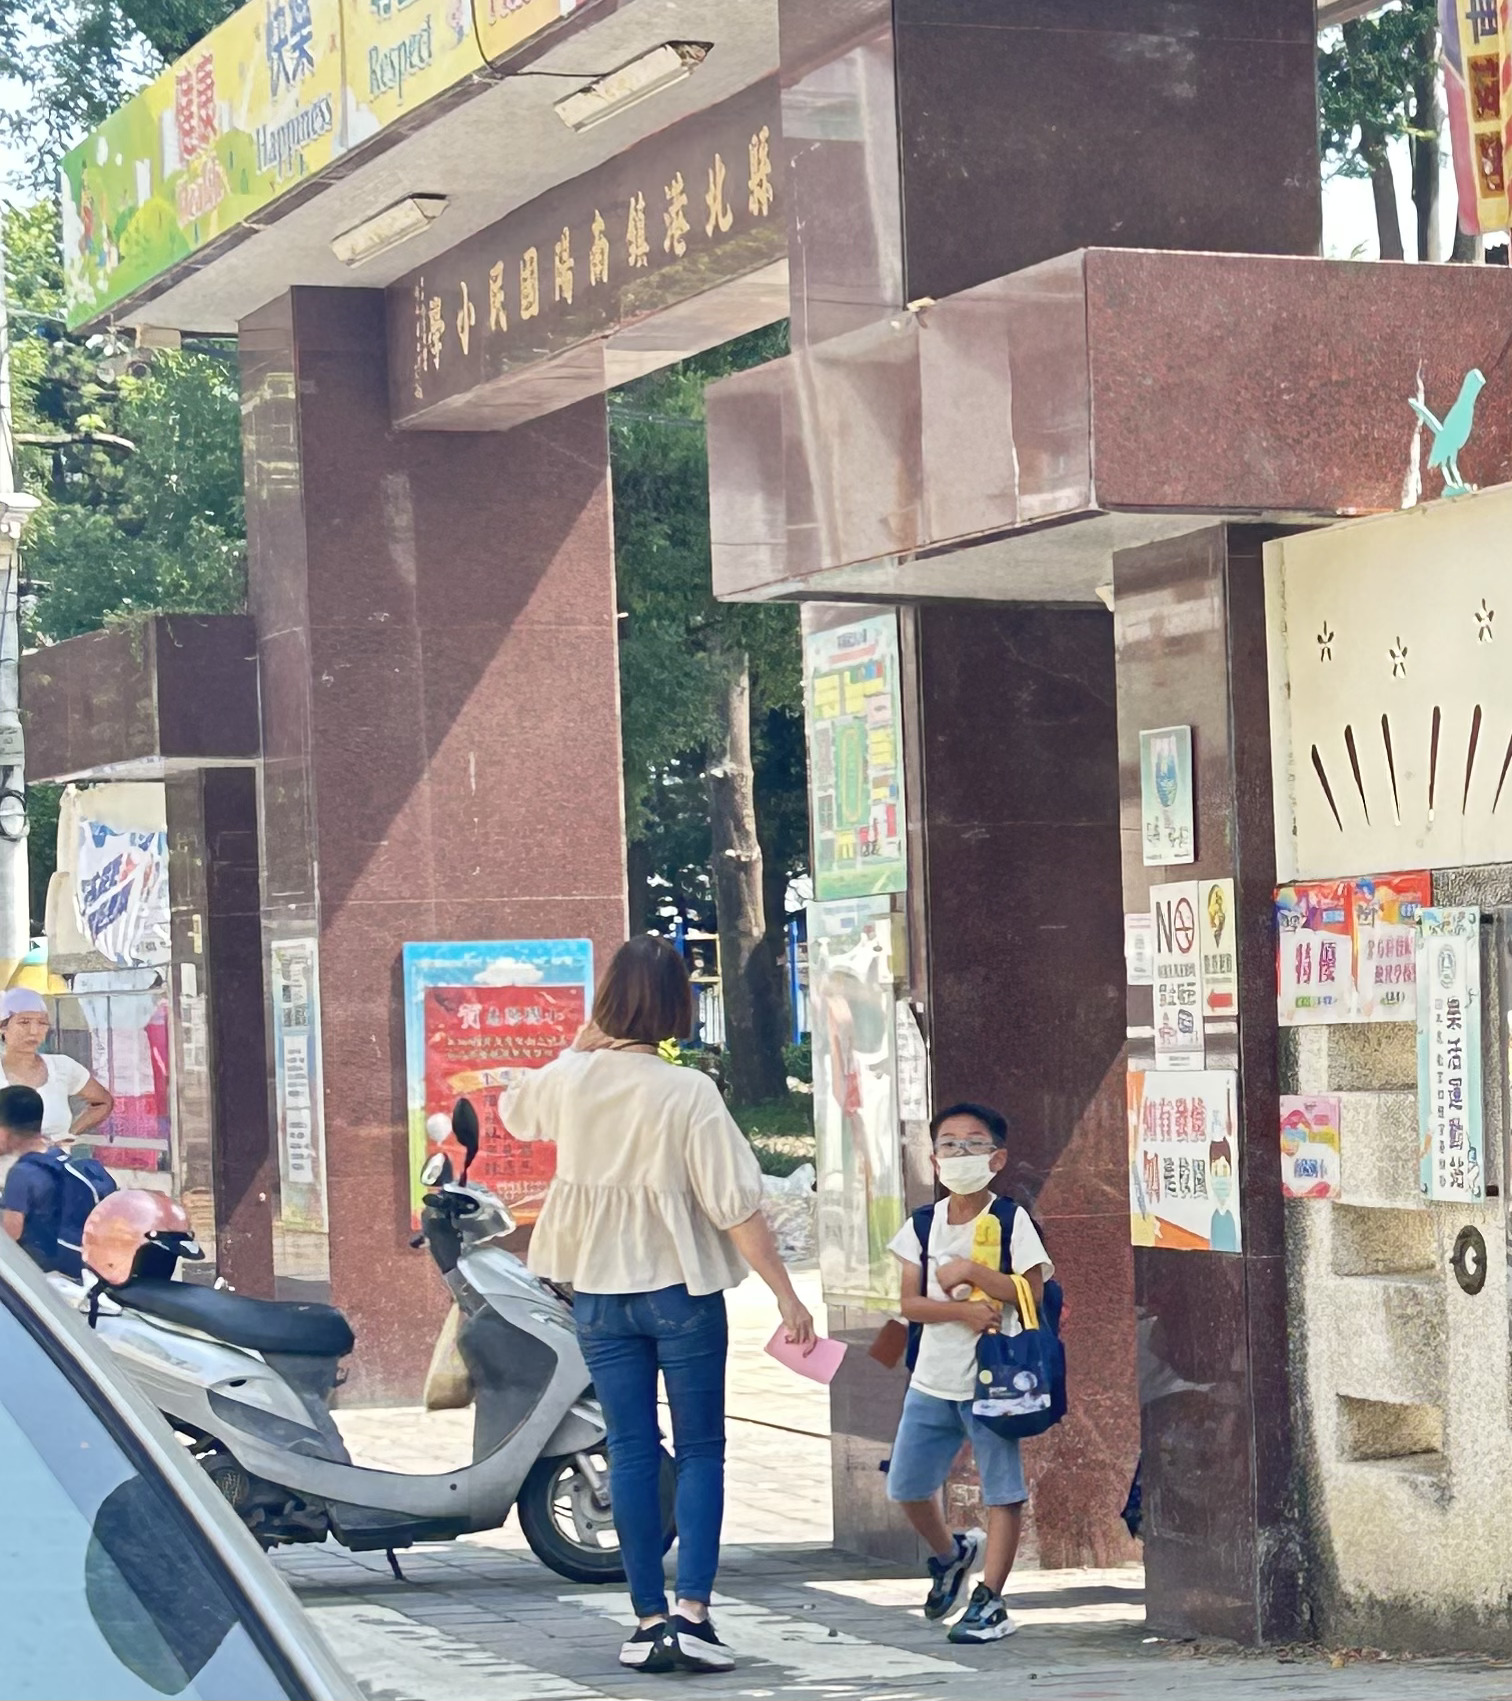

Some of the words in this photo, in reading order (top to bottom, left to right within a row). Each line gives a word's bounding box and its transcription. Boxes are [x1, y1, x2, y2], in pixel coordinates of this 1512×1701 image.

[369, 14, 433, 102] Respect
[255, 93, 333, 181] Happiness
[1295, 941, 1337, 985] 特優
